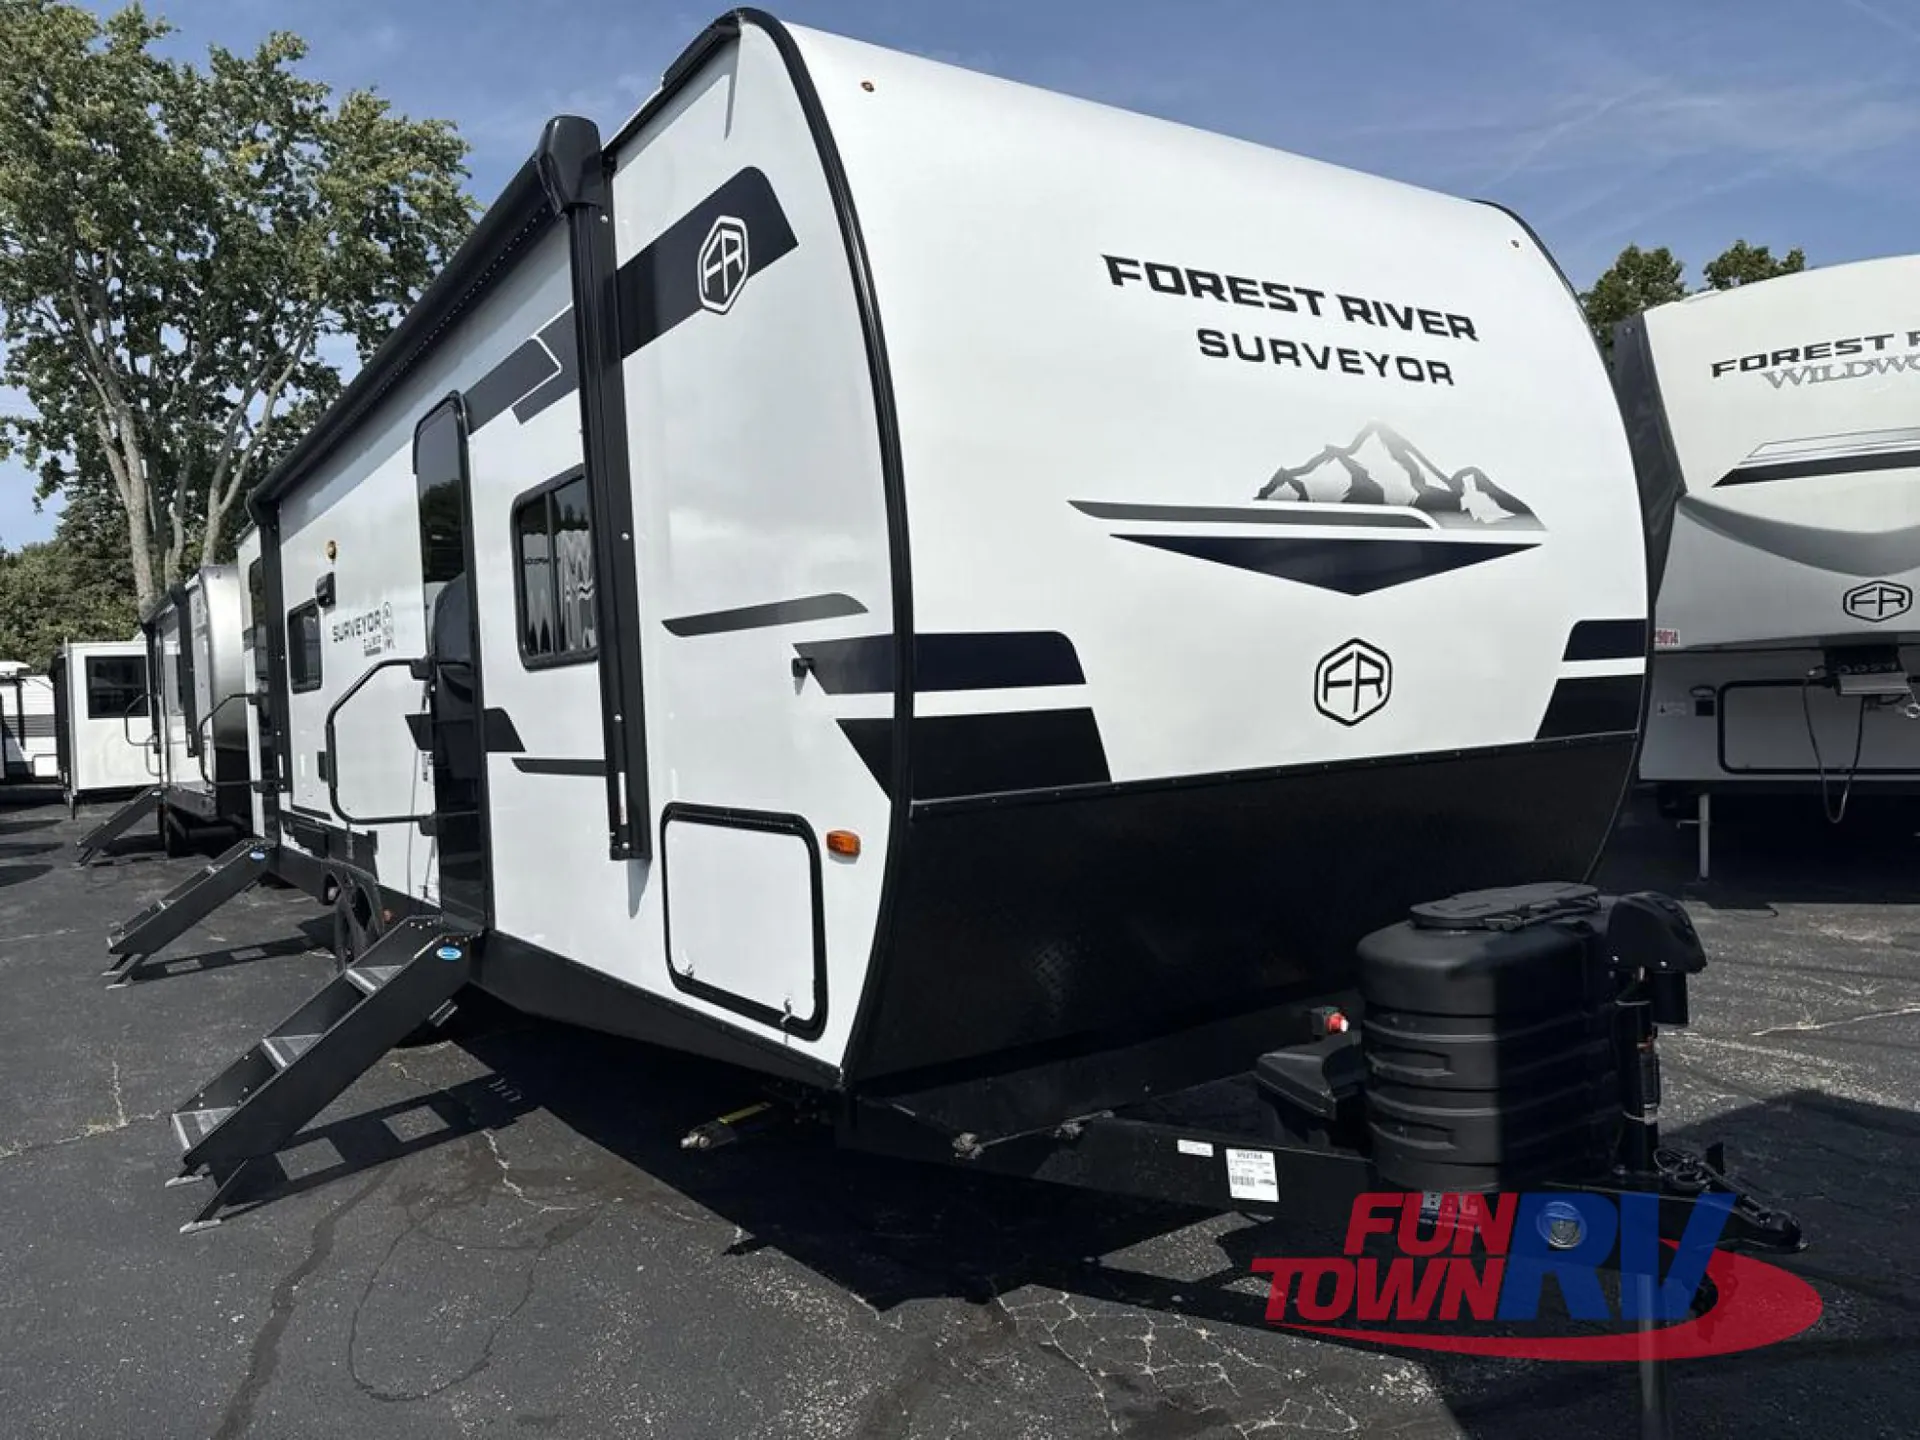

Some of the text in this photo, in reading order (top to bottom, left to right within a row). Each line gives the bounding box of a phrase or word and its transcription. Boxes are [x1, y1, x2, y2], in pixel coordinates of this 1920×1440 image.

[1102, 254, 1479, 342] FOREST RIVER
[1197, 328, 1456, 386] SURVEYOR
[1711, 333, 1895, 378] FOREST
